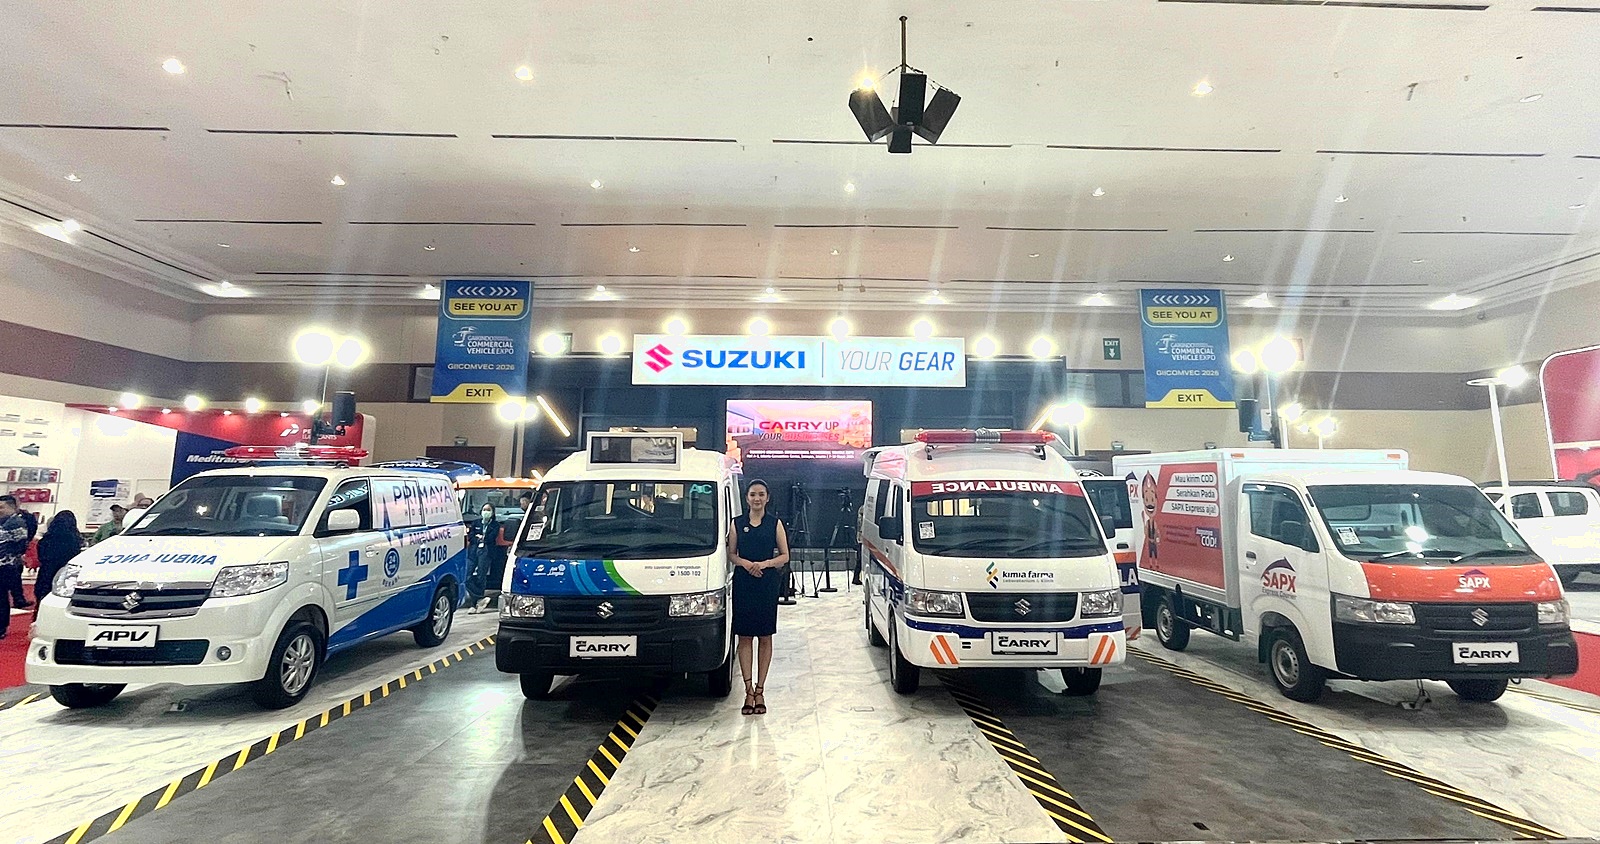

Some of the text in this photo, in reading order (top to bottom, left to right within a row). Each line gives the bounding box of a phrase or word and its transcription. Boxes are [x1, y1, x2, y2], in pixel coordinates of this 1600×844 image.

[454, 302, 475, 310] SEE
[479, 303, 501, 311] YOU
[682, 350, 956, 372] SUZUKI YOUR GEAR
[466, 388, 493, 397] EXIT
[1178, 394, 1204, 402] EXIT
[759, 422, 840, 430] CARRY UP
[759, 432, 783, 440] YOUR
[392, 486, 452, 504] PRIMAYA
[1130, 484, 1139, 498] PX
[1176, 489, 1215, 498] Serahkan Pada
[1172, 503, 1184, 511] SAPX
[1185, 504, 1205, 513] Express
[409, 528, 452, 546] AMBULANCE
[1201, 536, 1218, 548] COD!
[414, 544, 448, 566] 150 108
[1262, 570, 1296, 593] SAPX
[1459, 577, 1491, 588] SAPX
[93, 630, 150, 642] APV
[999, 640, 1050, 648] CARRY
